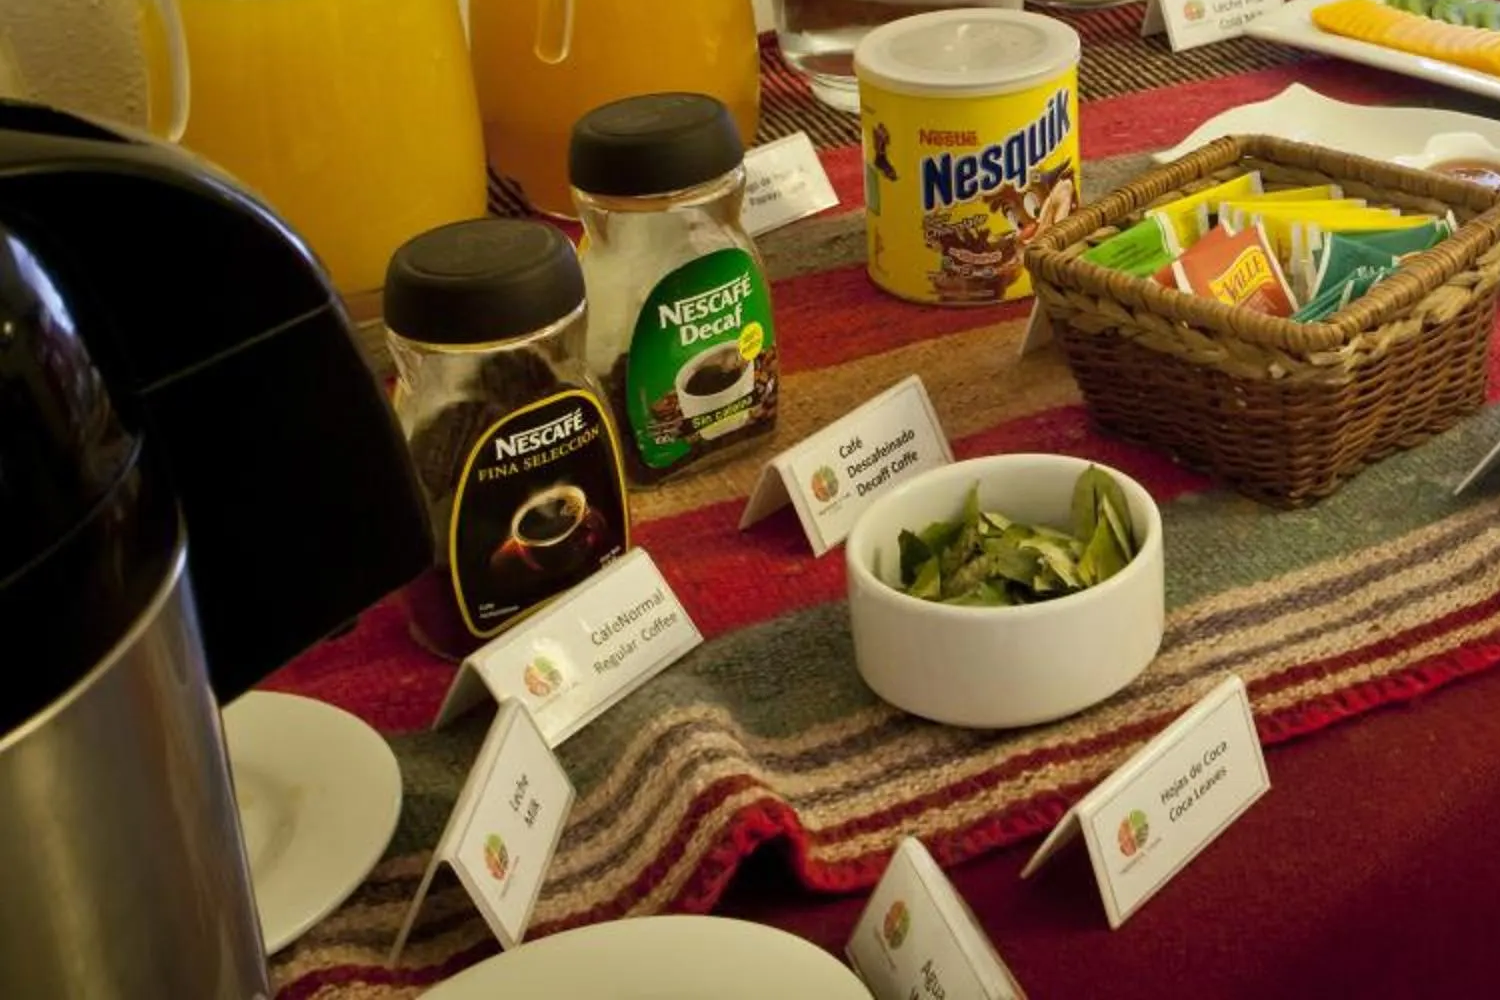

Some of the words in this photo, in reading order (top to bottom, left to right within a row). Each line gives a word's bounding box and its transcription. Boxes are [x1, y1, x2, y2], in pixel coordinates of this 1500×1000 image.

[922, 87, 1072, 211] Nesquik
[658, 271, 752, 330] NESCAFÉ
[679, 304, 744, 347] Decaf
[478, 462, 519, 482] FINA
[523, 424, 600, 471] SELECCIÓN
[494, 406, 586, 461] NESCAFÉ
[839, 435, 864, 460] Café
[847, 428, 916, 480] Descafeinado
[856, 468, 891, 497] Decaff
[891, 449, 919, 474] Coffe
[592, 638, 640, 676] Regular
[640, 611, 678, 642] Coffee
[1159, 775, 1189, 806] Hojas
[1189, 763, 1201, 780] de
[1202, 740, 1228, 768] Coca
[1168, 798, 1194, 823] Coca
[1194, 766, 1228, 800] Leaves
